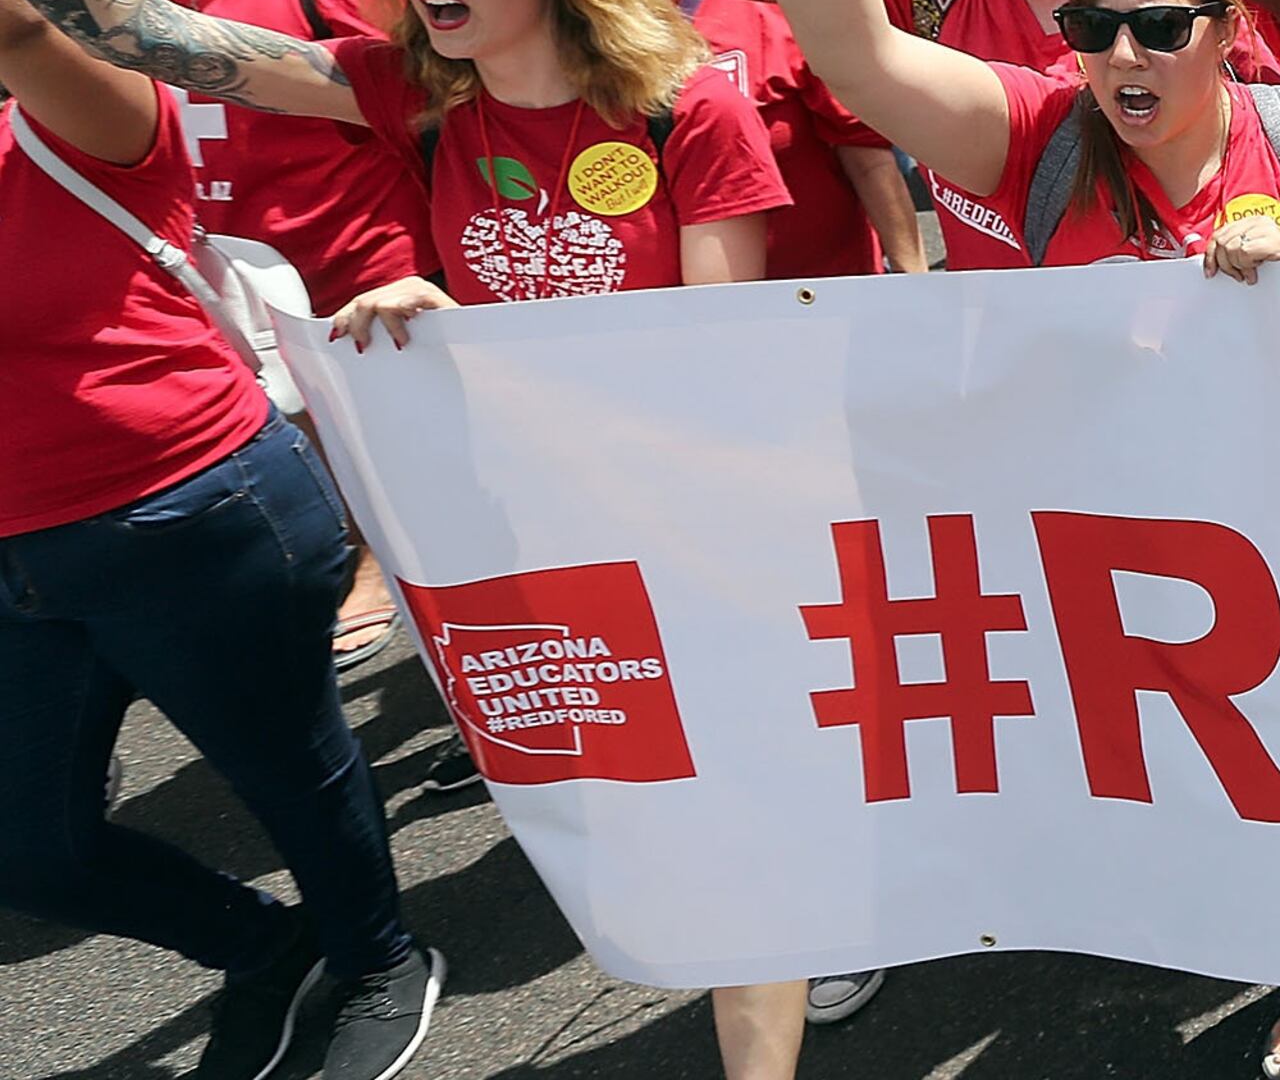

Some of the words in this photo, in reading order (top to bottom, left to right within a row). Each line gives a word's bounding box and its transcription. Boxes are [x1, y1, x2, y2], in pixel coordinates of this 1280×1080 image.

[576, 166, 619, 195] WANT
[617, 154, 640, 169] TO
[582, 147, 625, 178] DON'T
[584, 162, 652, 205] WALKOUT
[462, 637, 612, 673] ARIZONA
[467, 657, 664, 696] EDUCATORS
[477, 687, 600, 717] UNITED
[487, 709, 627, 734] #REDFORED
